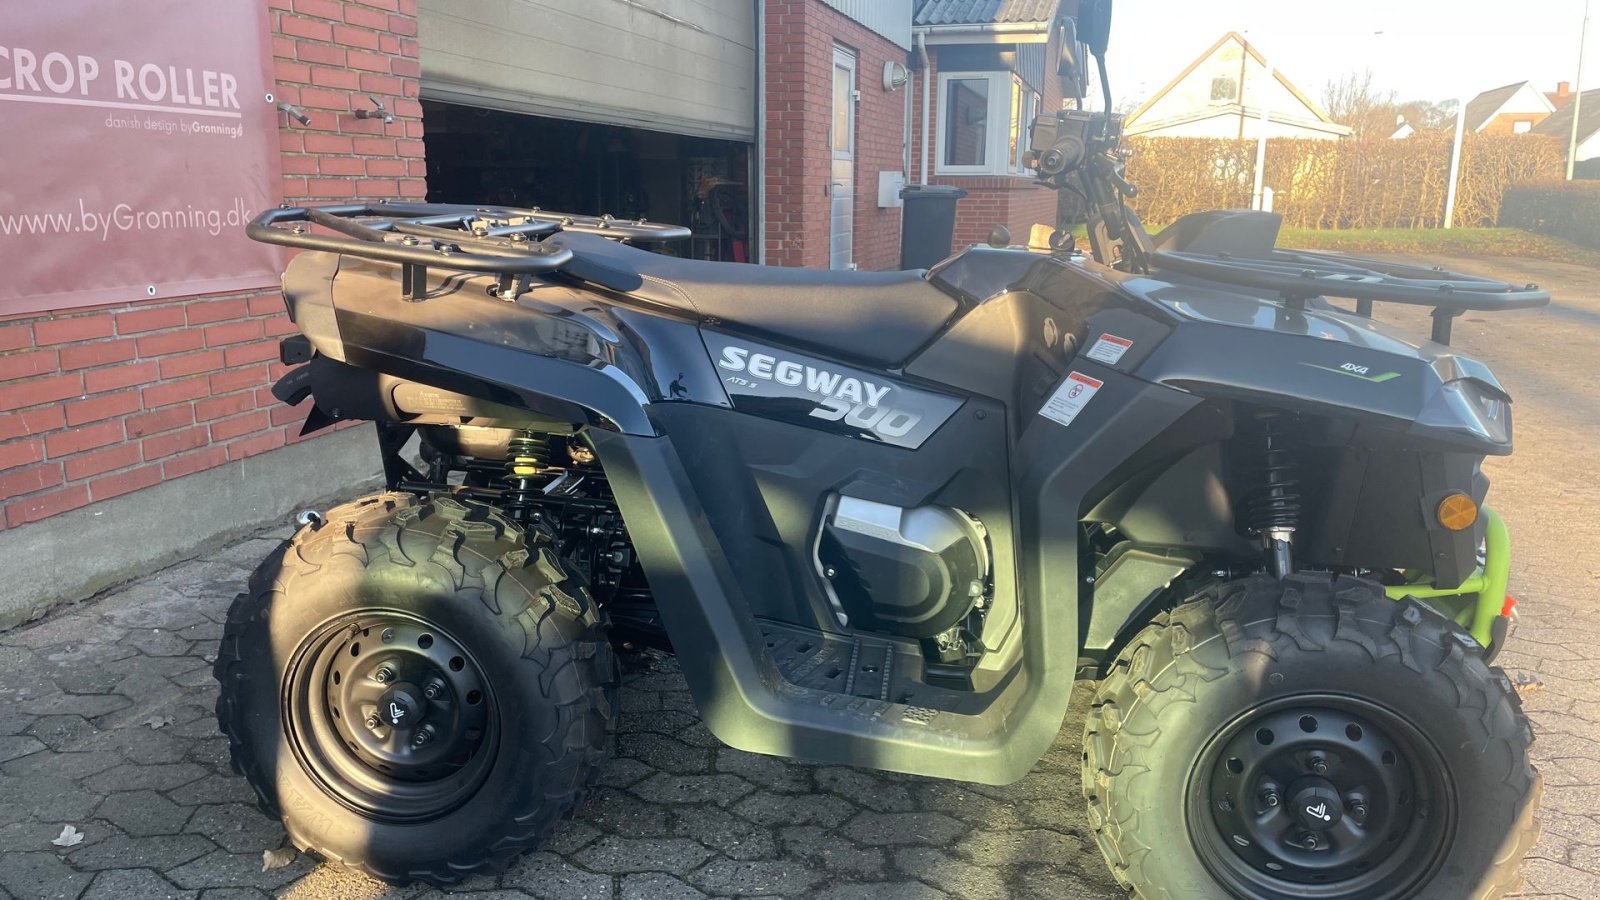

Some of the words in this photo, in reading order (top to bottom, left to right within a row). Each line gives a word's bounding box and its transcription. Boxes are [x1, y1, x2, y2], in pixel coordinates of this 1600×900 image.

[114, 59, 240, 109] ROLLER
[105, 112, 141, 129] danish
[144, 115, 177, 135] design
[0, 197, 251, 241] www.byGronning.dk
[718, 346, 891, 409] SEGWAY
[809, 397, 923, 437] 500
